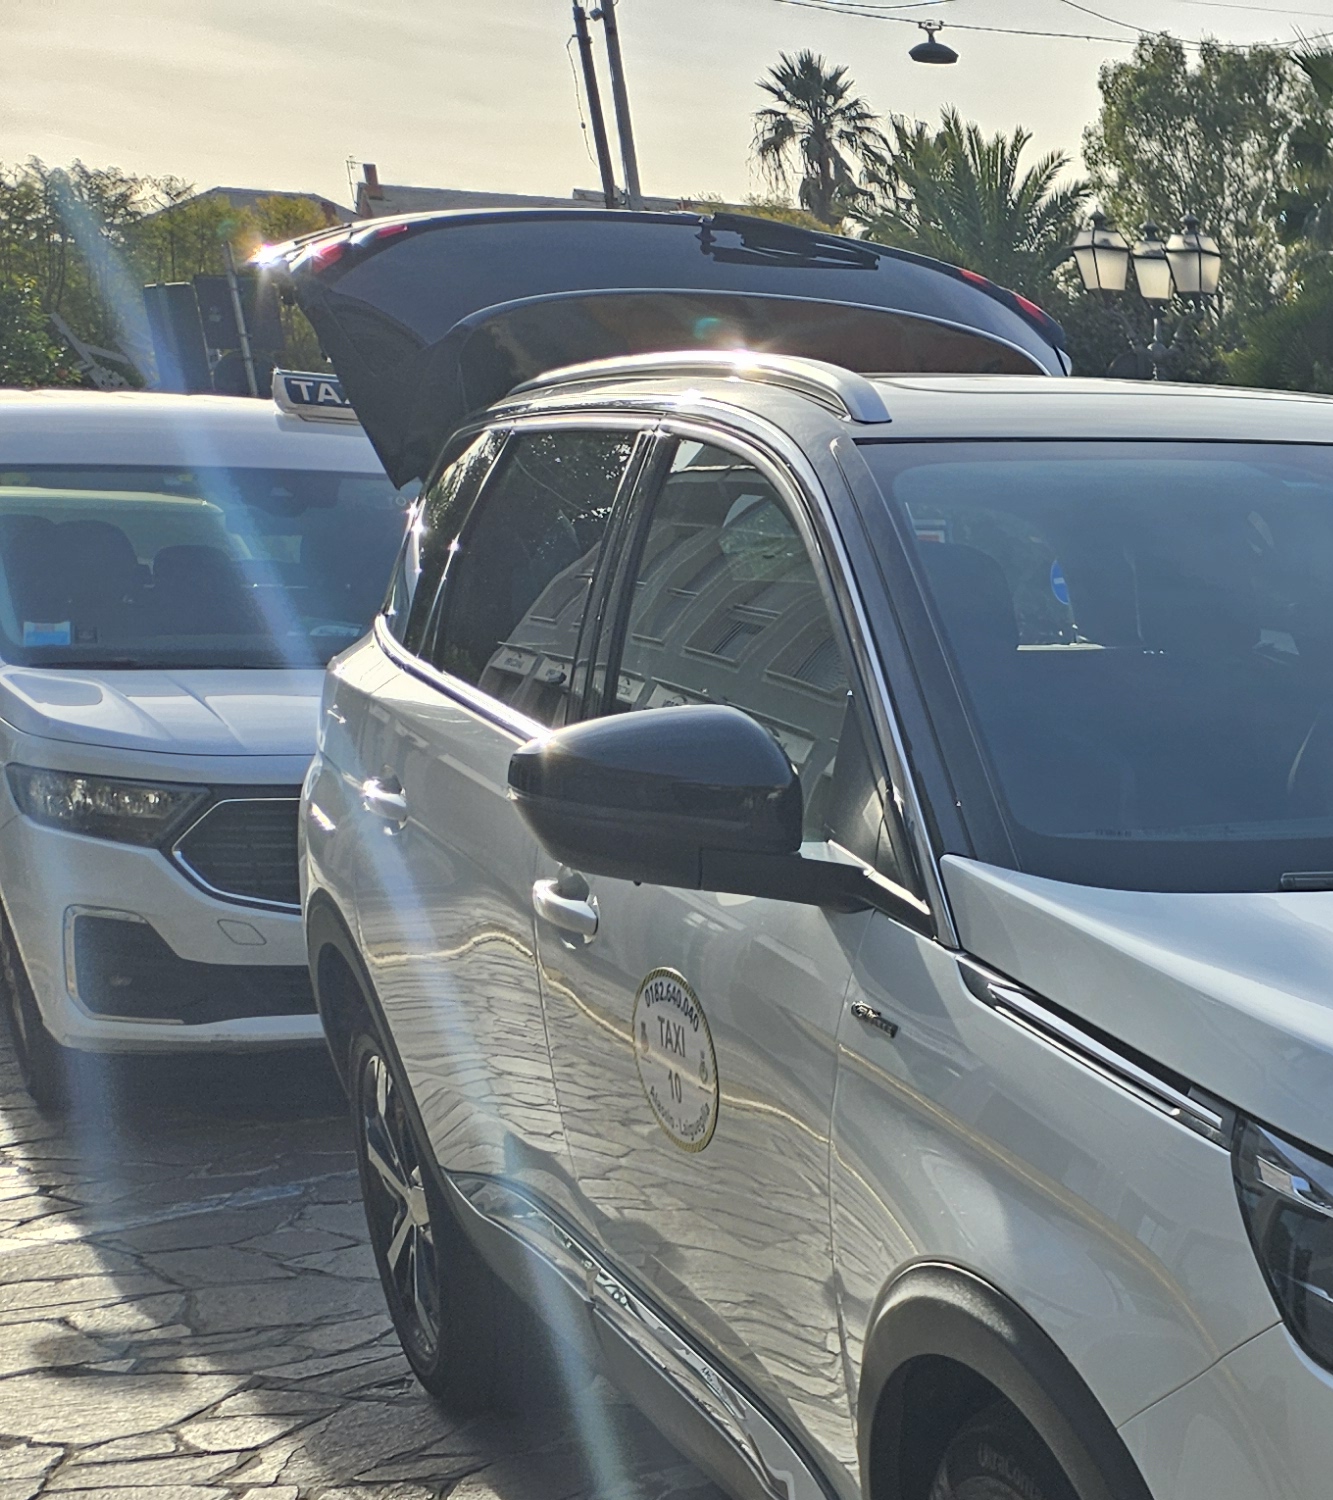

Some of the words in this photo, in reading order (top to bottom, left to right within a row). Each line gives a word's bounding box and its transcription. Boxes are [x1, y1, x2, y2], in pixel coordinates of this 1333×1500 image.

[291, 380, 350, 404] TA
[658, 1016, 686, 1058] TAXI
[667, 1069, 682, 1104] 10
